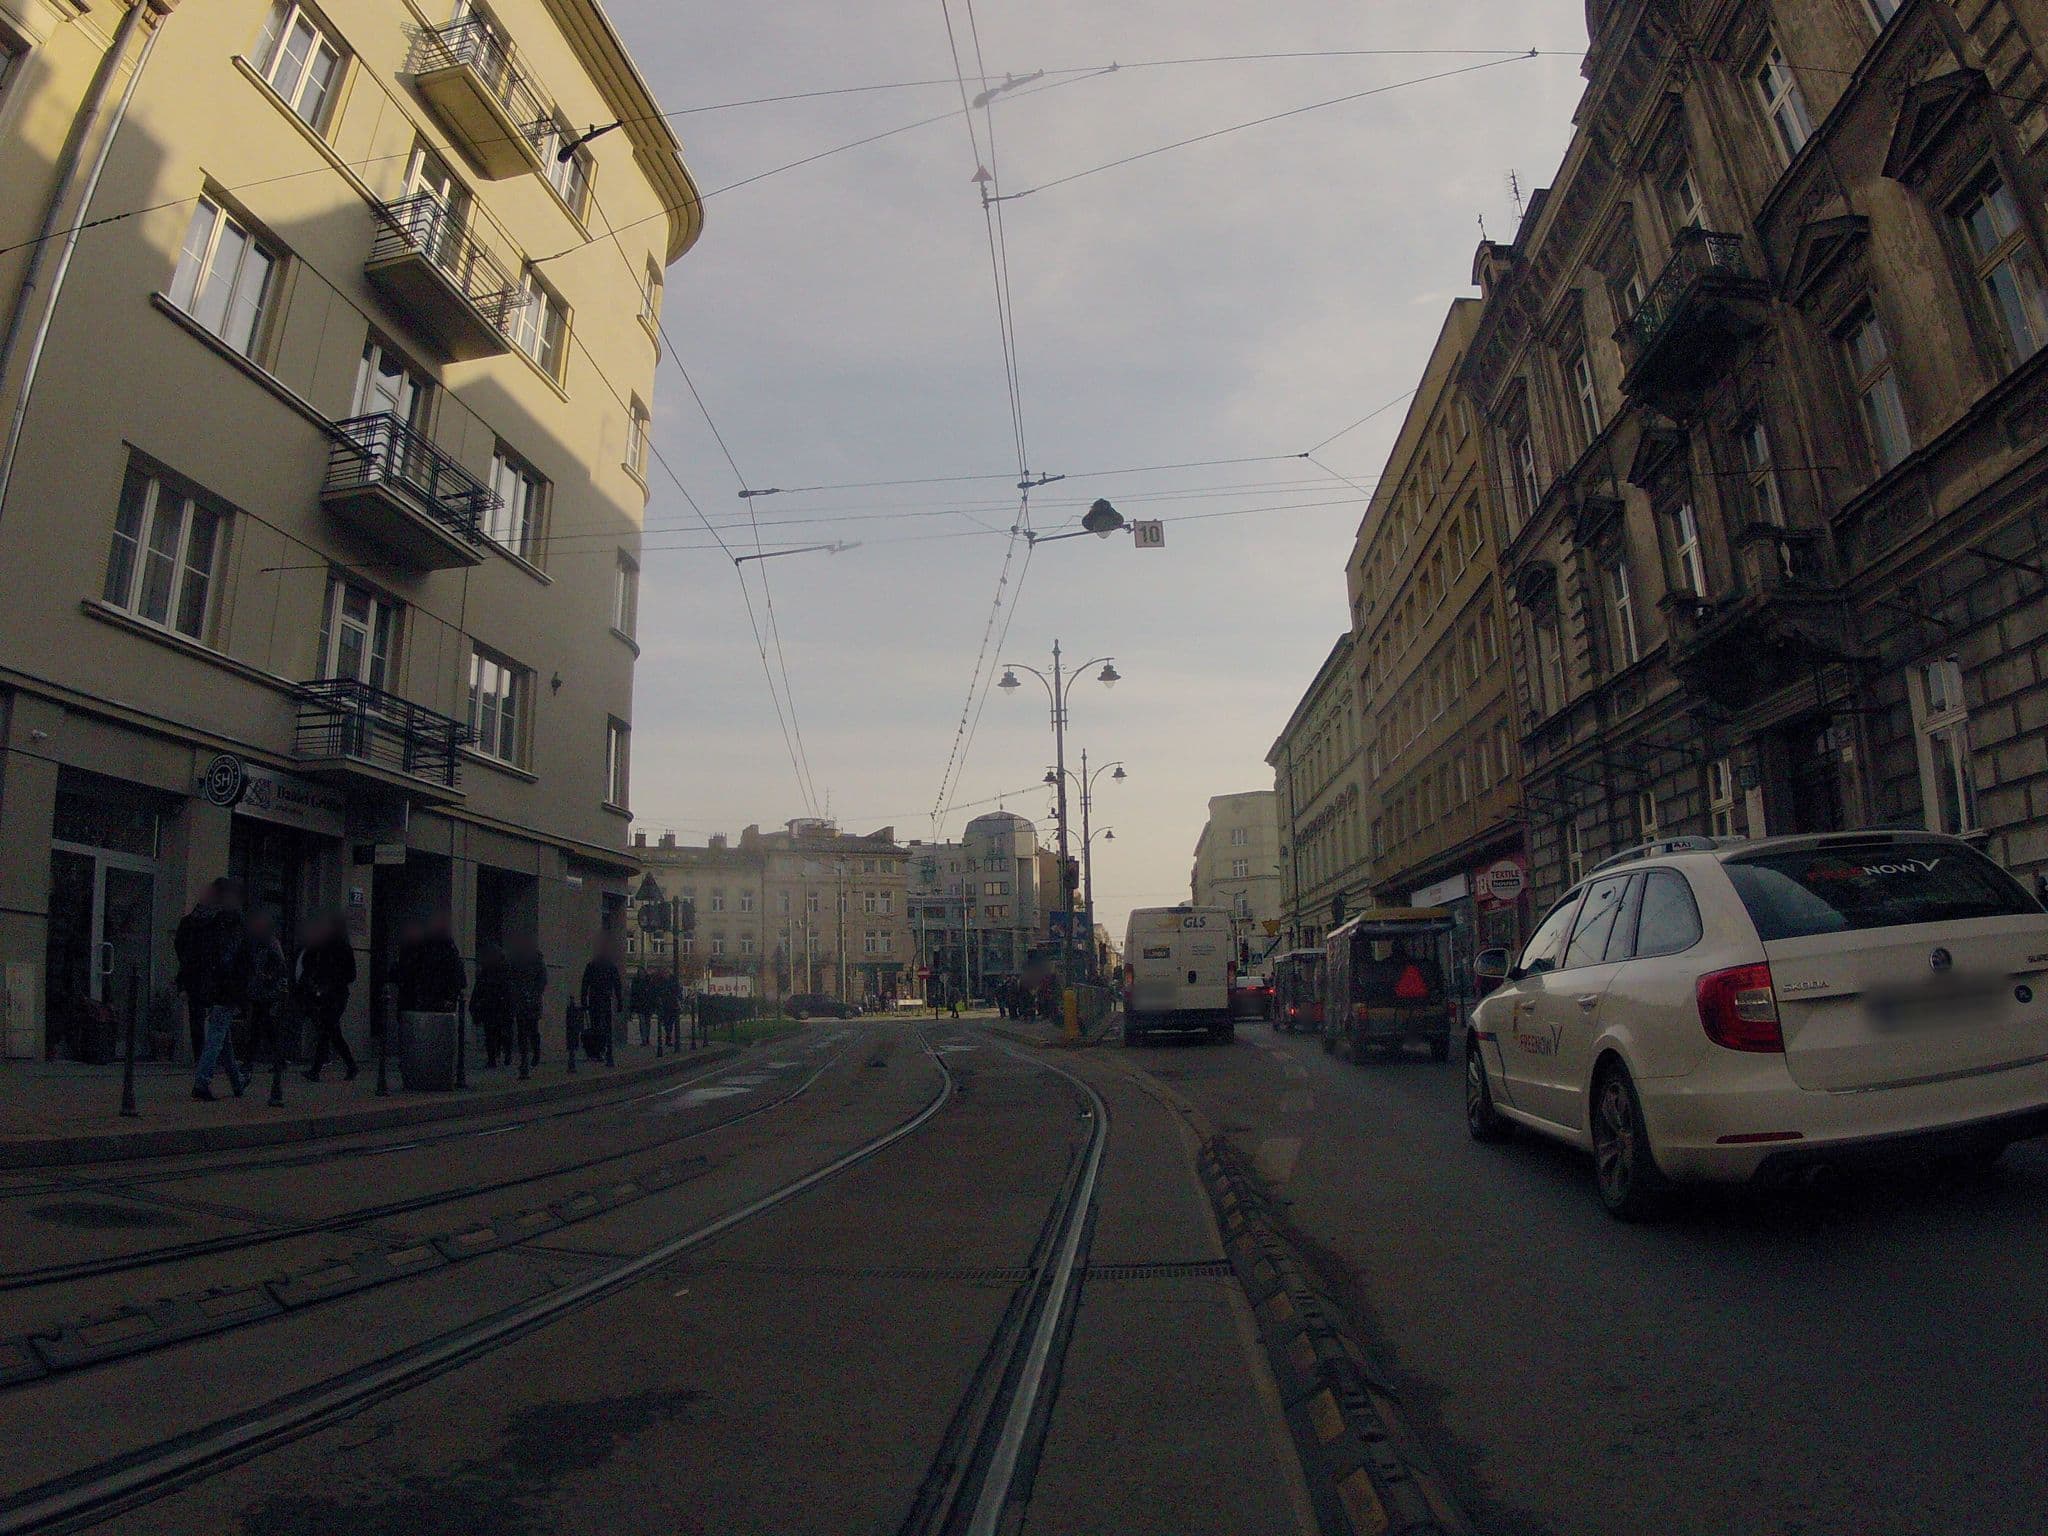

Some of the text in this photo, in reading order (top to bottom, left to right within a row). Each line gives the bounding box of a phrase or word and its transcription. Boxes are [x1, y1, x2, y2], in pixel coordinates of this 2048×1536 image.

[1140, 525, 1161, 543] 10
[214, 772, 231, 787] SH
[1491, 869, 1521, 879] TEXTILE
[1183, 916, 1207, 928] GLS
